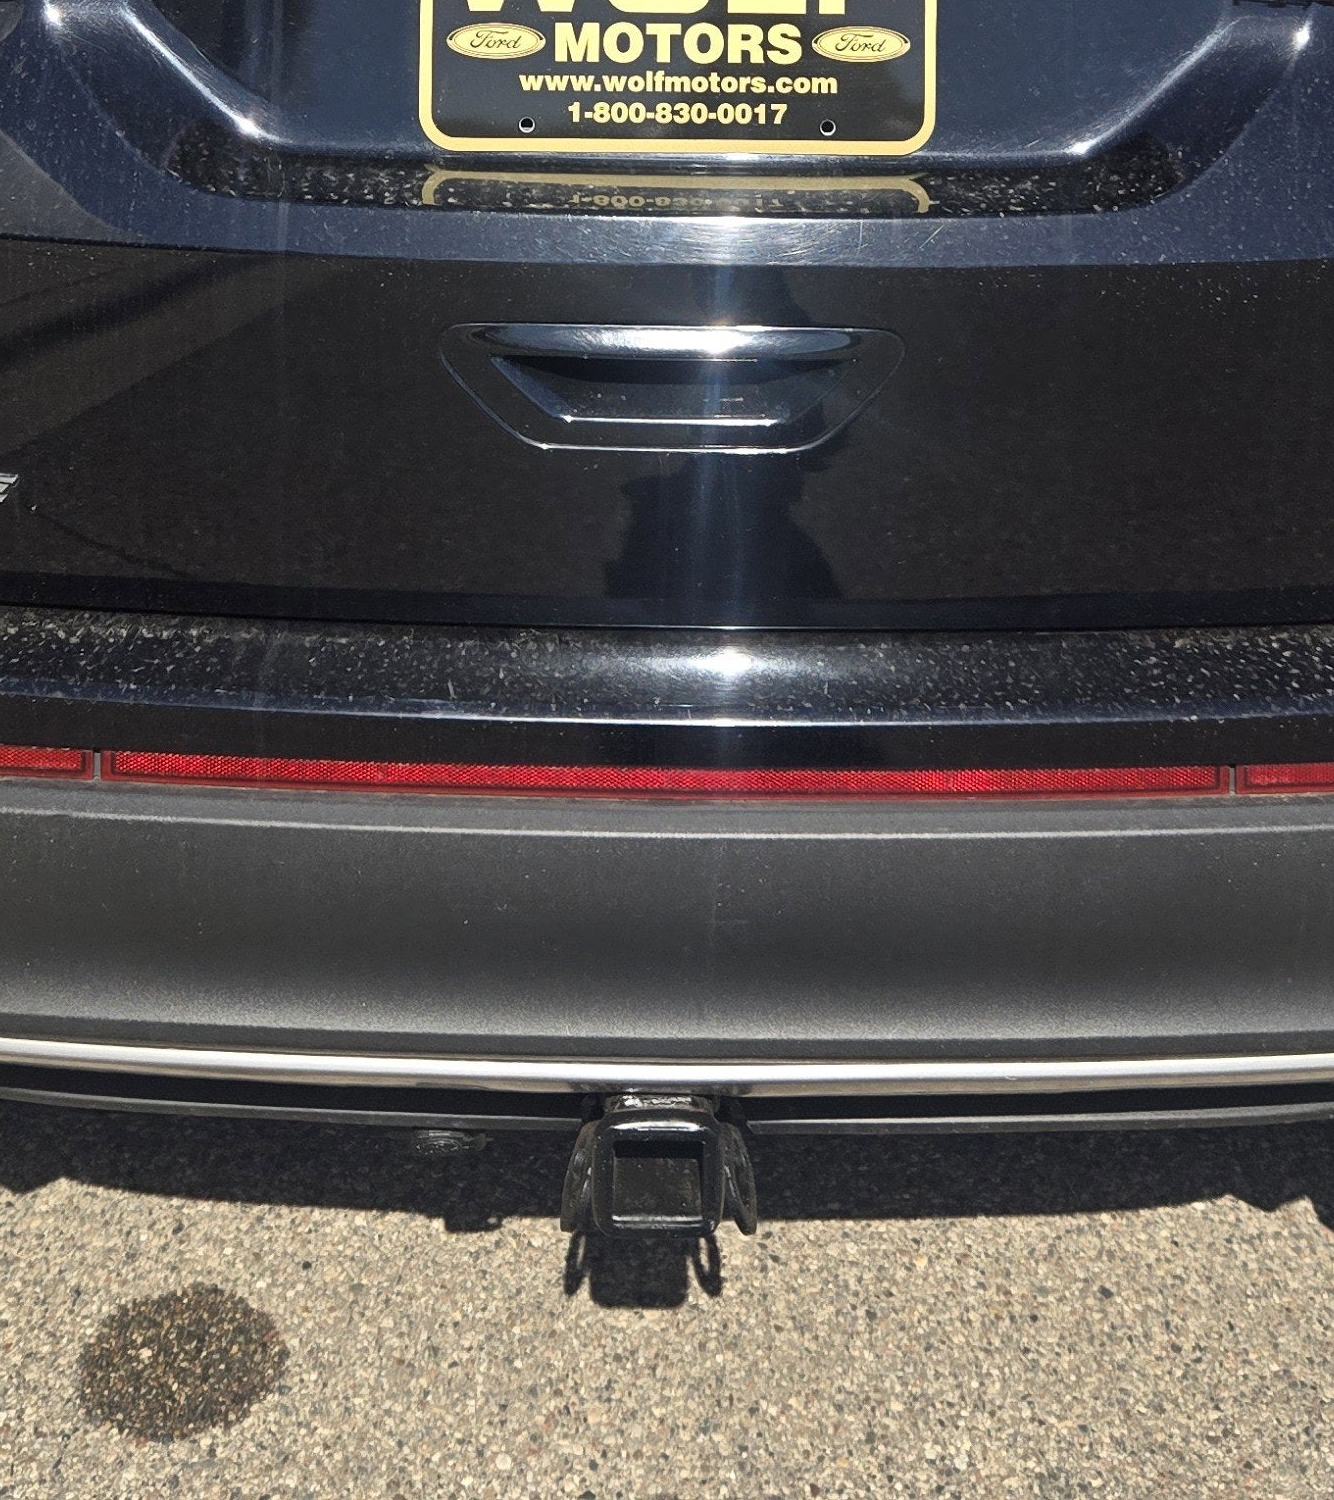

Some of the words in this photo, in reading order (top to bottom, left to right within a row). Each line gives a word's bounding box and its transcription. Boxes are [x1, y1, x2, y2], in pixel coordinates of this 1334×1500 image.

[469, 30, 522, 51] Ford
[554, 22, 802, 64] MOTORS
[833, 33, 887, 55] Ford
[519, 70, 838, 95] www.wolfmotors.com
[568, 101, 788, 125] 1-800-830-0017
